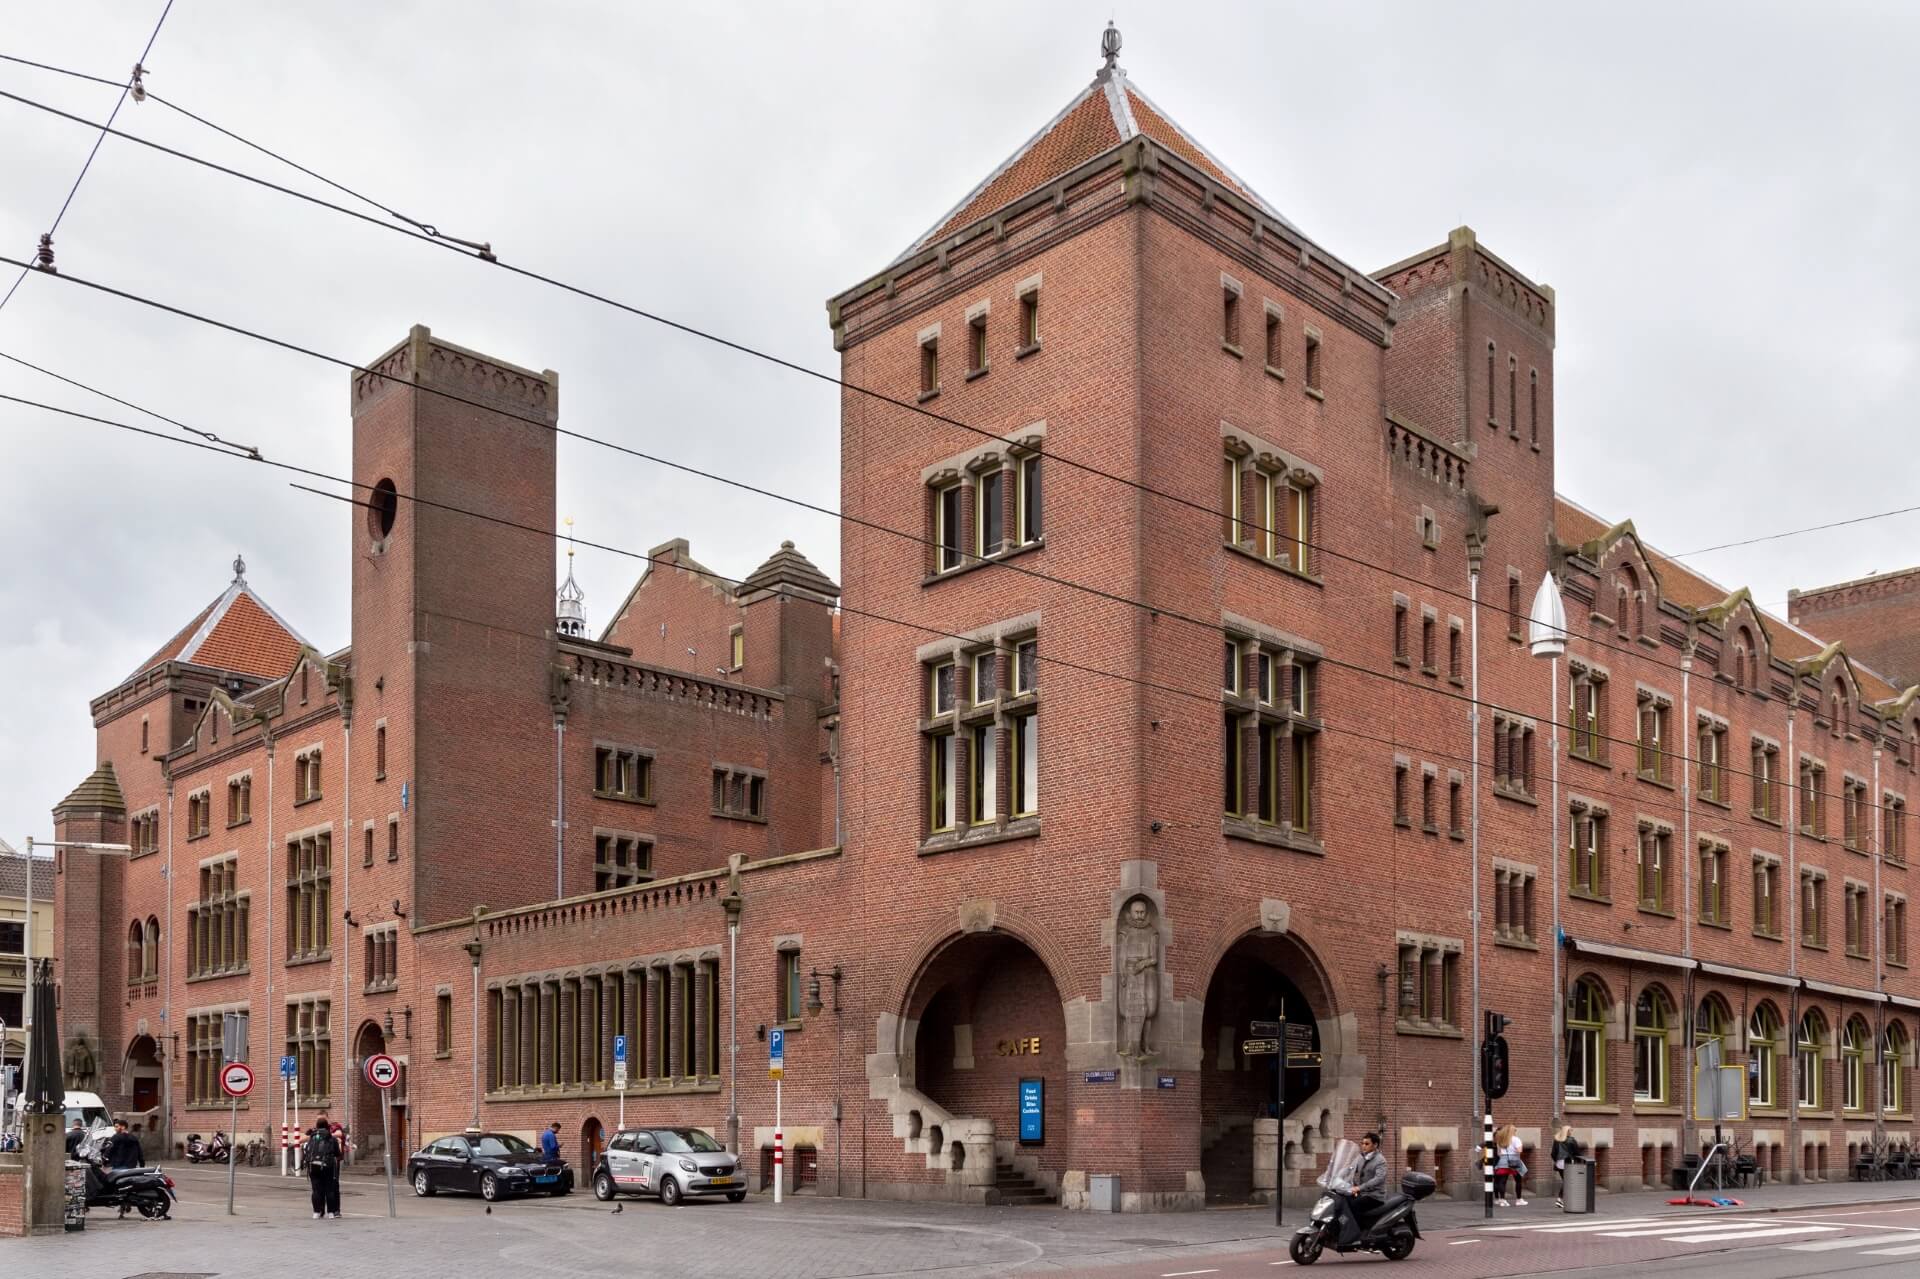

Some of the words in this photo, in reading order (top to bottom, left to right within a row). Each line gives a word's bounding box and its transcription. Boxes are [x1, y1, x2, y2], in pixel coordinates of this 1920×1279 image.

[617, 1038, 624, 1051] P
[773, 1032, 780, 1047] P
[998, 1037, 1040, 1056] CAFE
